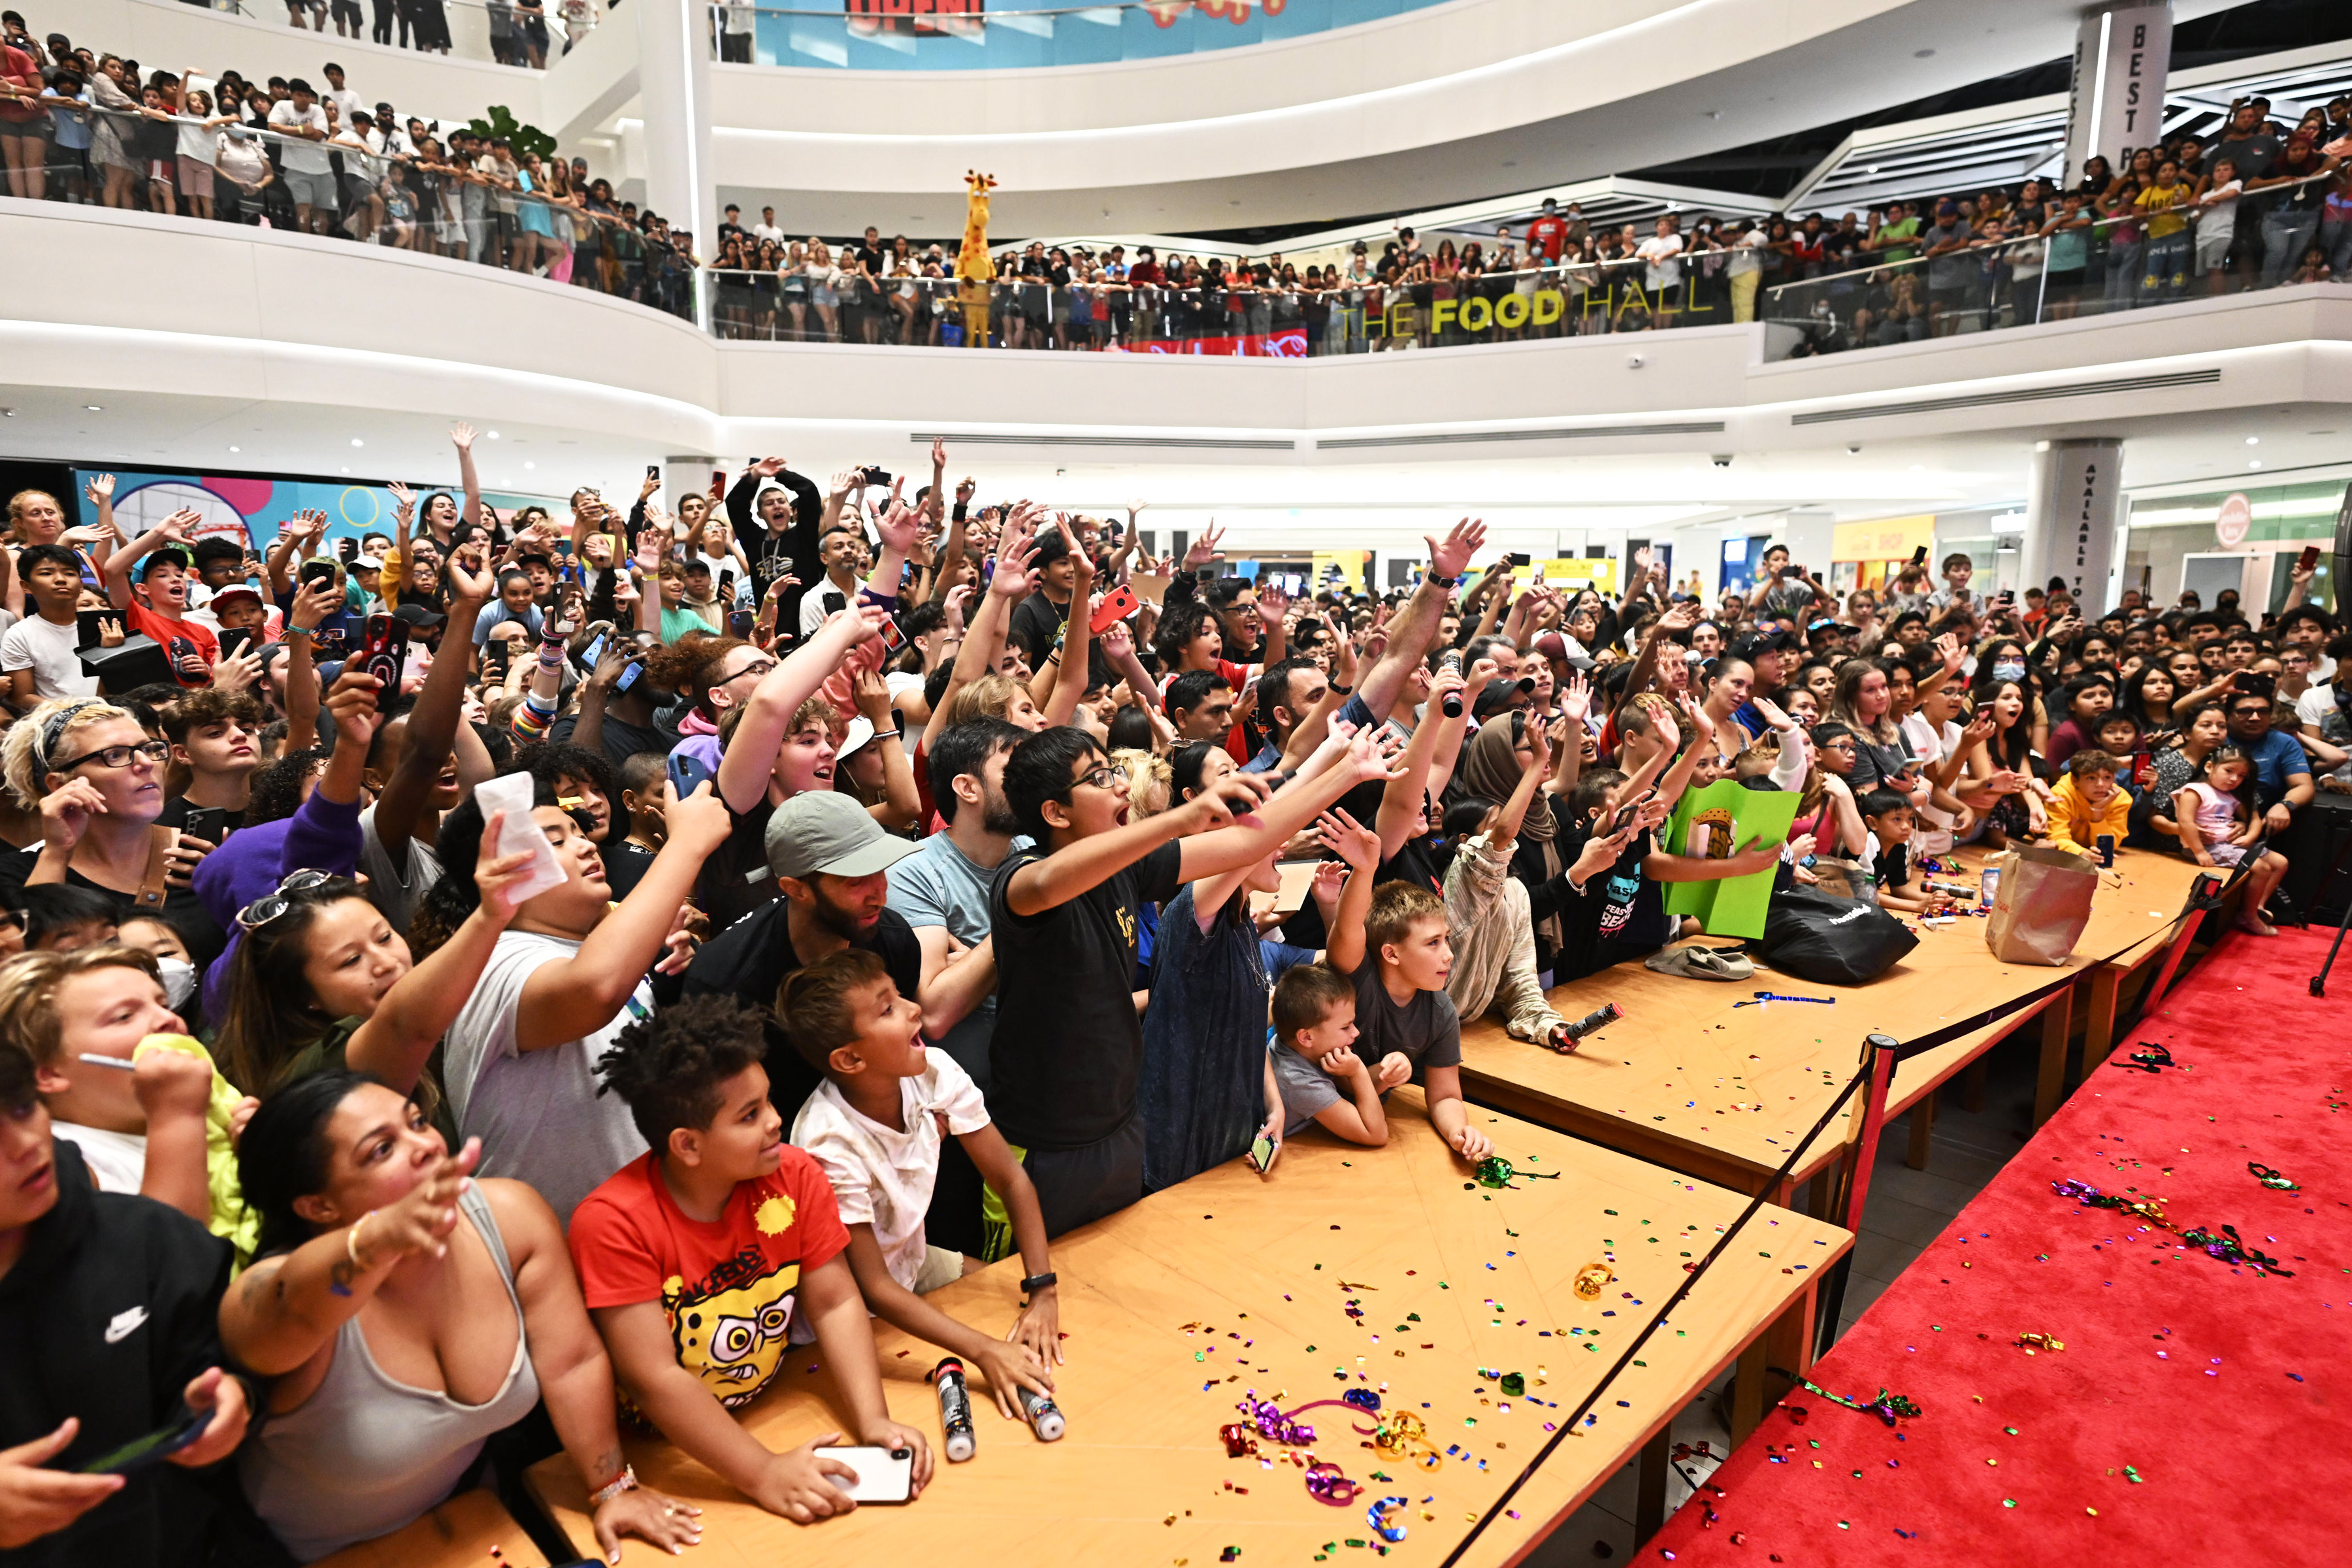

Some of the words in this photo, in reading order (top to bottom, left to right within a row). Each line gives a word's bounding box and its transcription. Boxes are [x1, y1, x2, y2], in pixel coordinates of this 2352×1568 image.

[2125, 24, 2146, 133] BEST
[1335, 302, 1416, 342] THE
[1431, 289, 1564, 334] FOOD
[1582, 276, 1714, 321] HALL
[2076, 463, 2097, 567] AVAILABLE
[2072, 577, 2083, 597] TO
